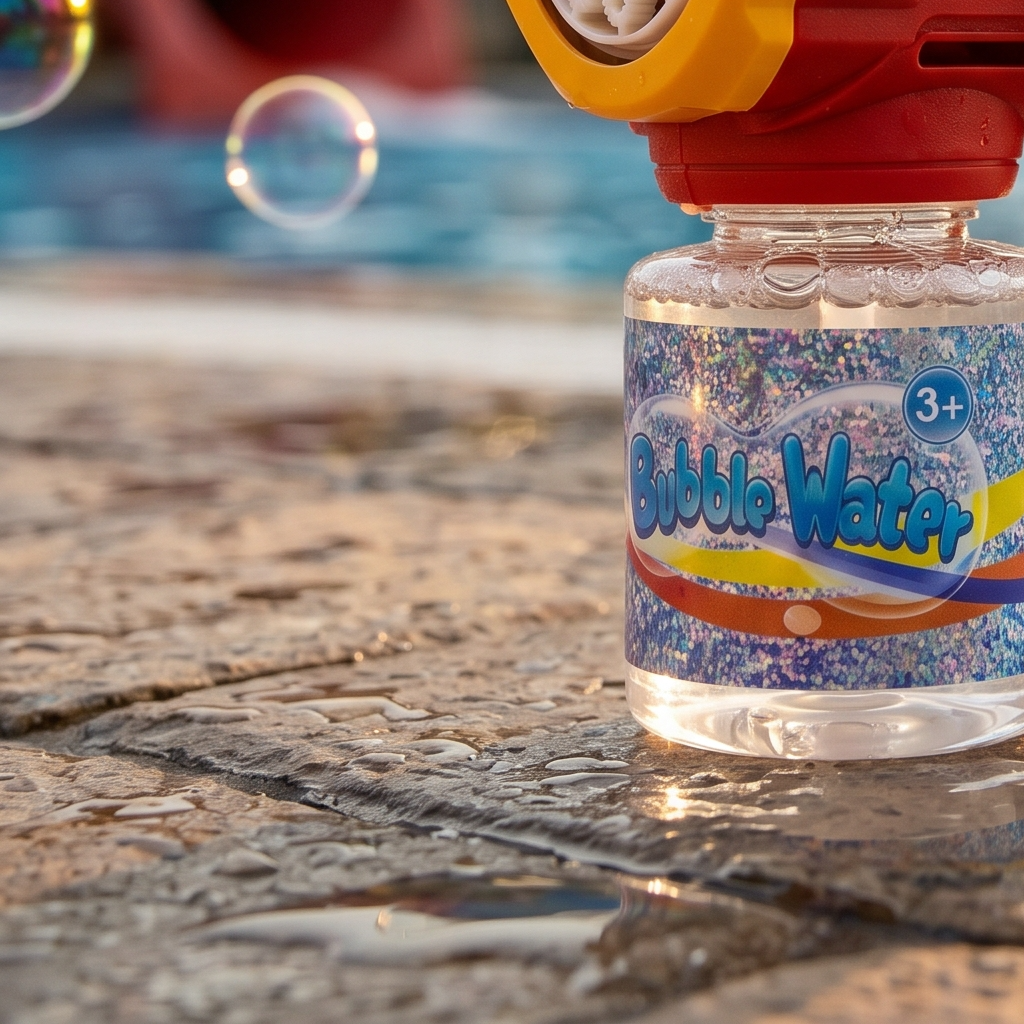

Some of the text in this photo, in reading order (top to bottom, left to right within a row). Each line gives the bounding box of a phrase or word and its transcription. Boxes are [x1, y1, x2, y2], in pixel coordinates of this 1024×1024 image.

[915, 387, 964, 423] 3+
[629, 431, 974, 564] Bubble Water
